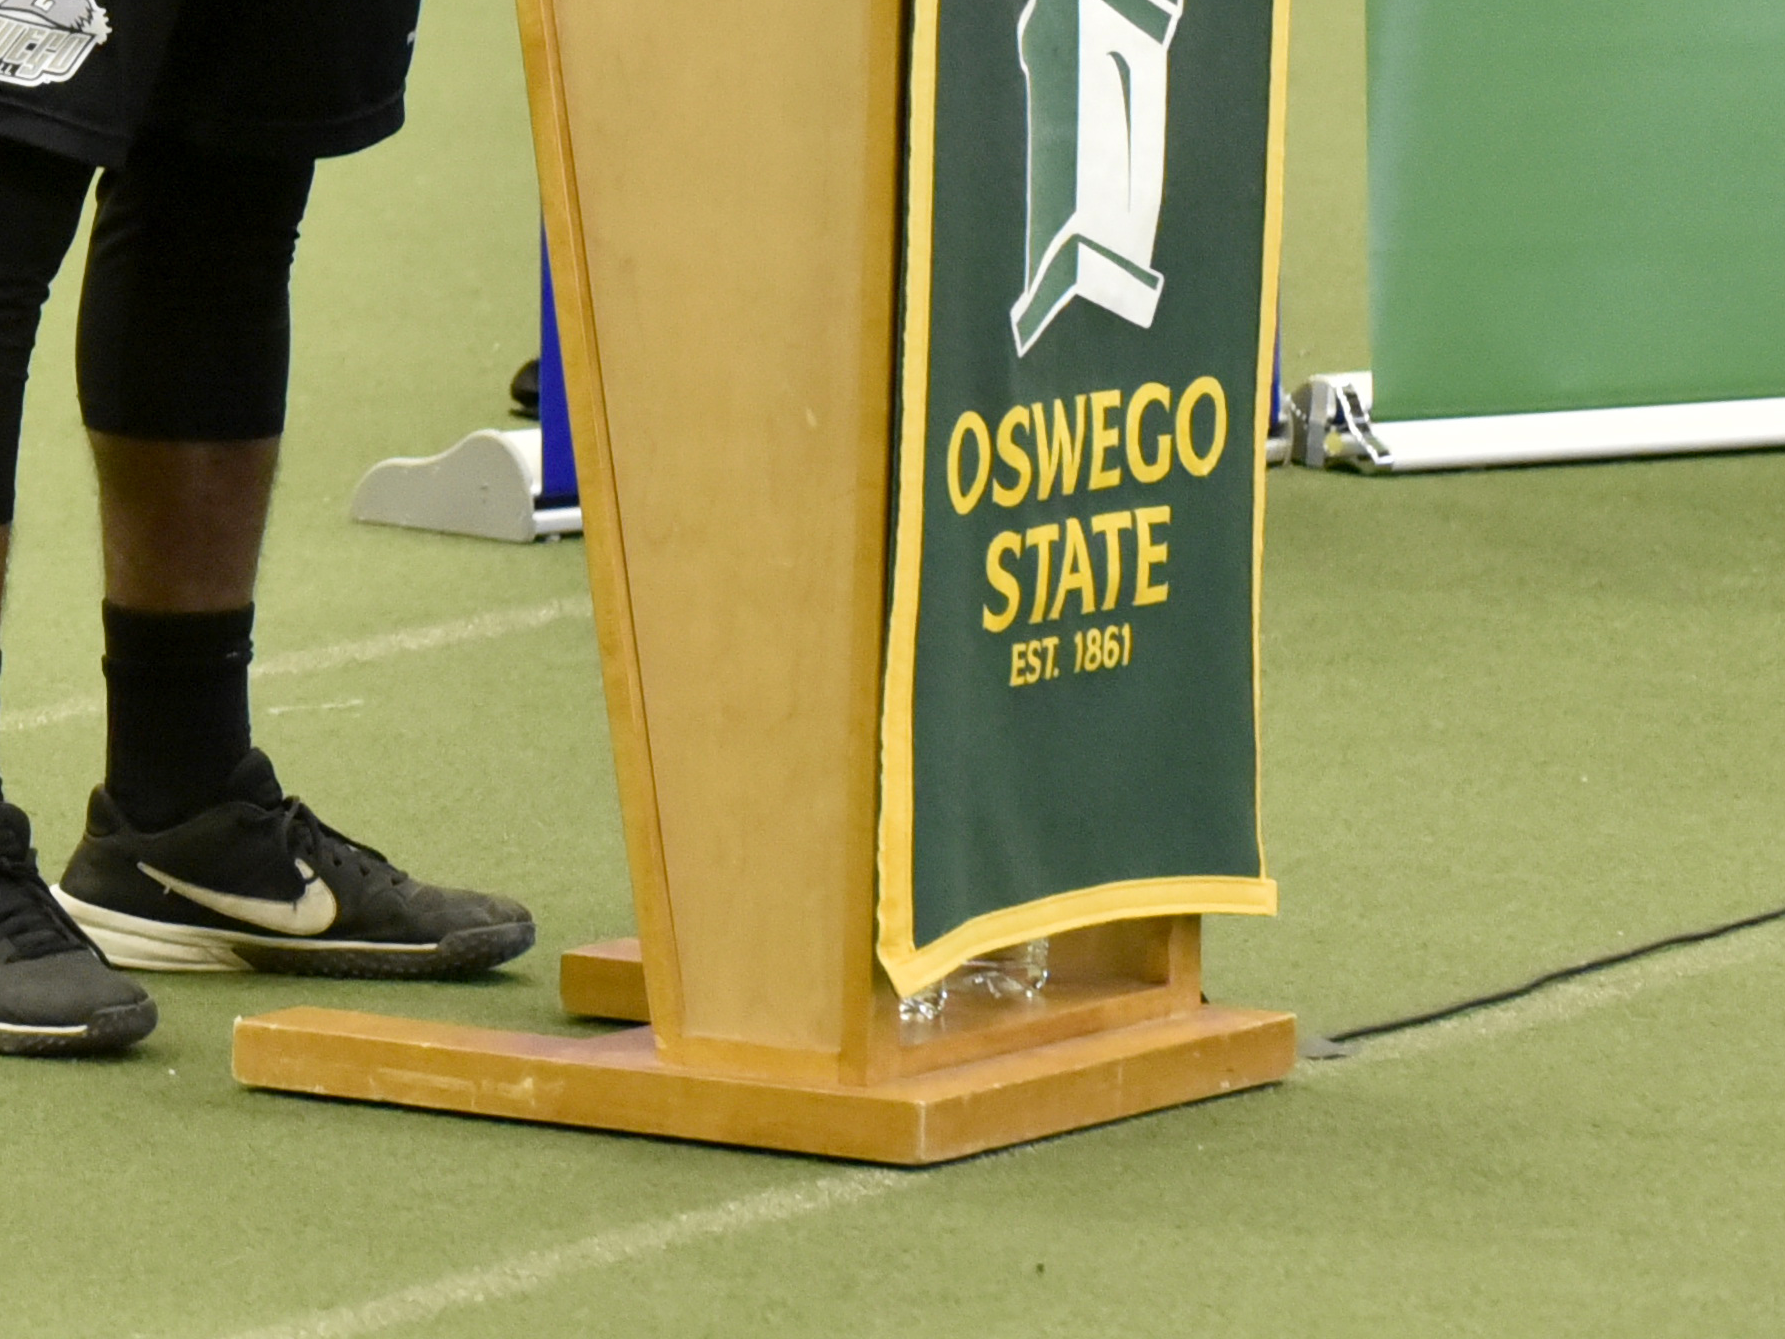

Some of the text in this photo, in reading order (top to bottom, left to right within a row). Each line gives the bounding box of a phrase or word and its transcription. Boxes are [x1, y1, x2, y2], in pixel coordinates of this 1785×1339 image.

[947, 375, 1227, 515] OSWEGO
[983, 505, 1171, 633] STATE
[1010, 623, 1132, 687] EST. 1861
